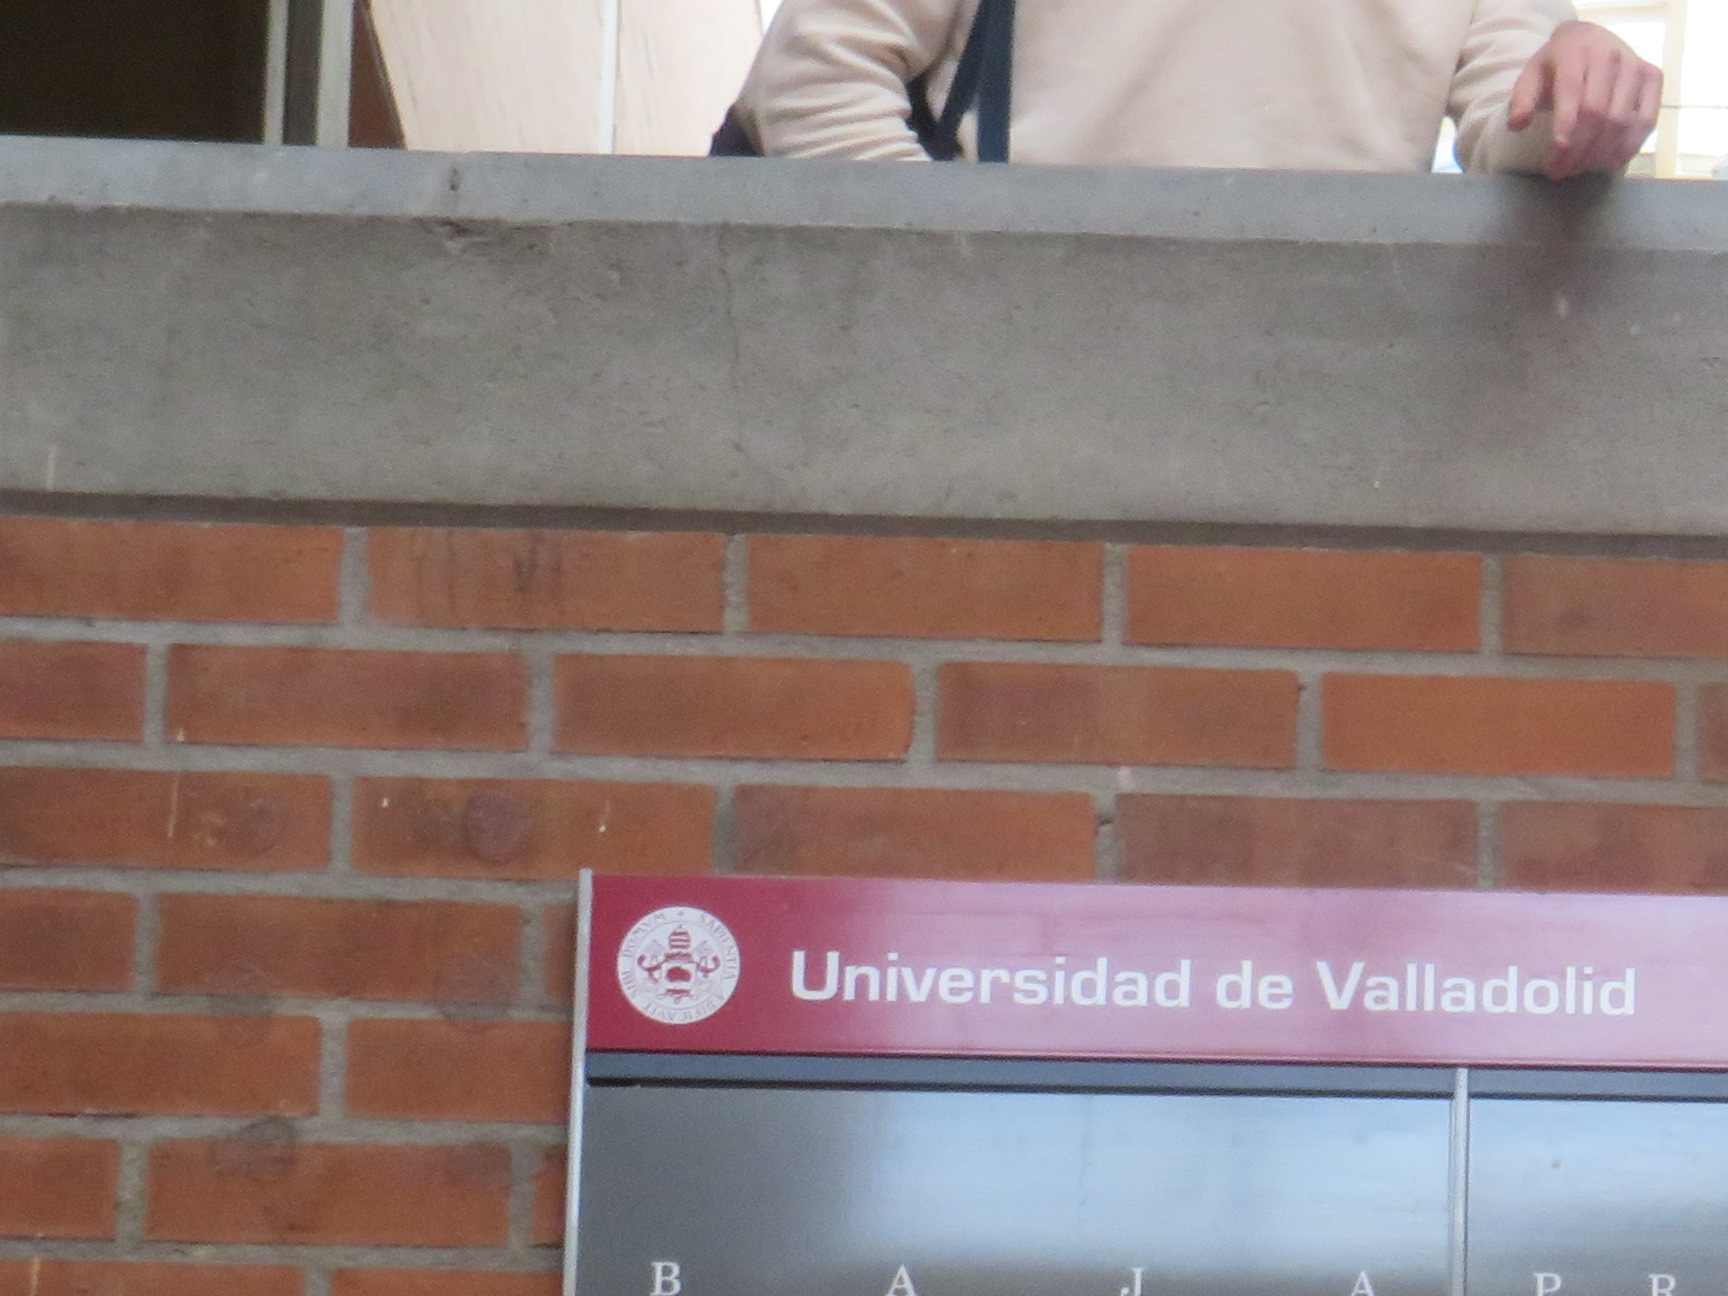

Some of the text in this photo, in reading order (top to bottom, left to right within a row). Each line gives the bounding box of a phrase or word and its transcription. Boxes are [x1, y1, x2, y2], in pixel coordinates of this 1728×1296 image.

[790, 948, 1192, 1008] Universidad
[1215, 958, 1293, 1011] de
[1315, 959, 1636, 1016] Valladolid
